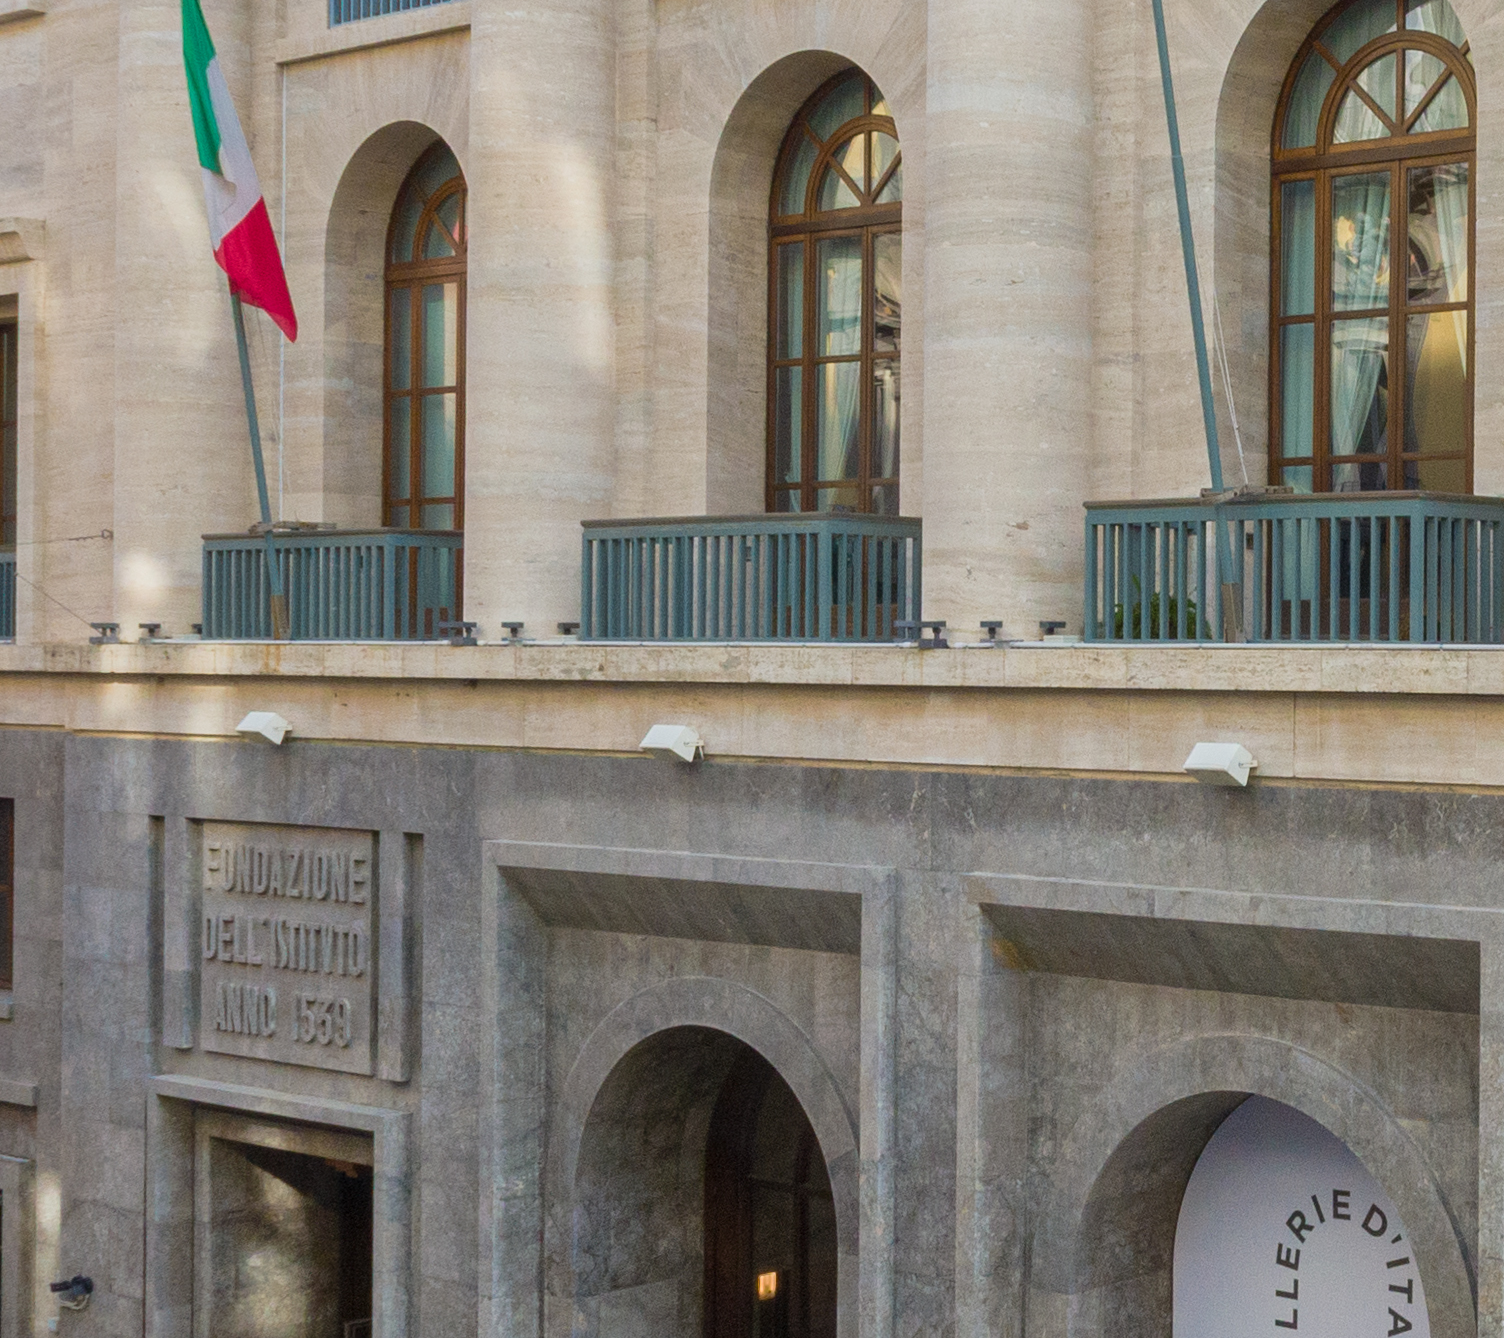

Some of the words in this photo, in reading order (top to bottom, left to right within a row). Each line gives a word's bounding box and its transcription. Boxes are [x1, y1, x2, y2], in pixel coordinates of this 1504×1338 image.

[205, 841, 368, 904] FONDAZIONE
[214, 981, 277, 1038] ANNO
[292, 991, 352, 1049] 1539
